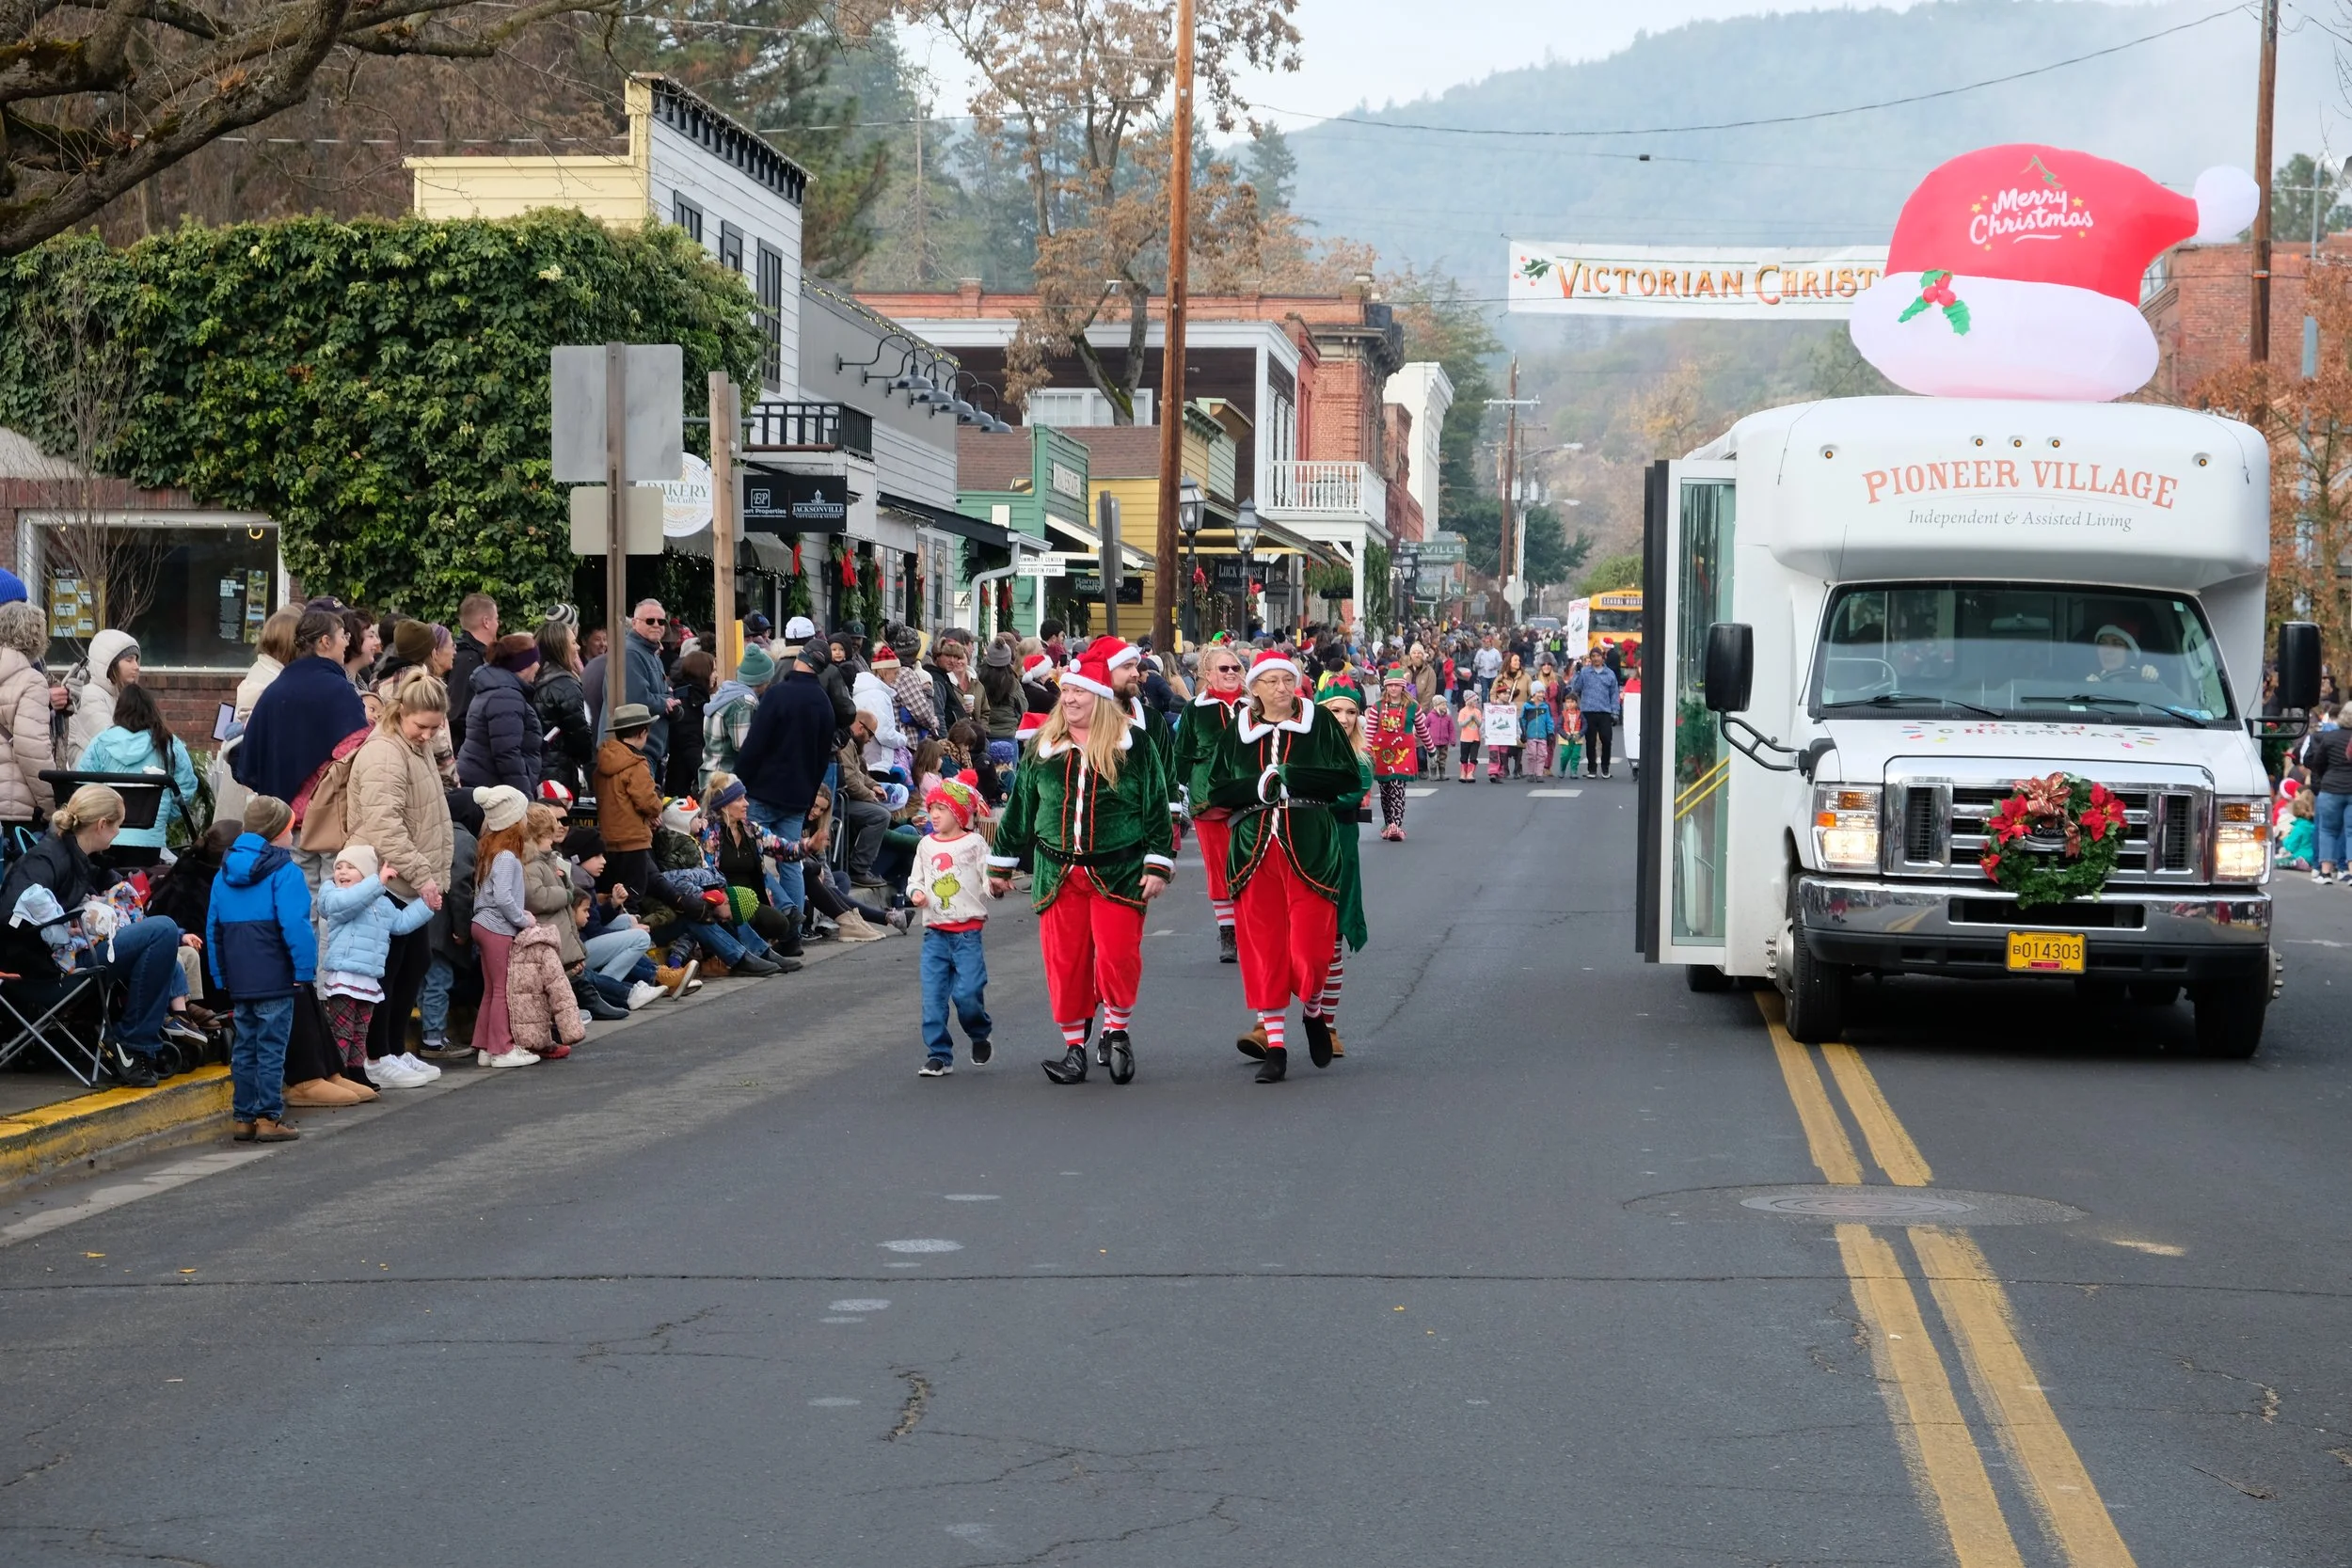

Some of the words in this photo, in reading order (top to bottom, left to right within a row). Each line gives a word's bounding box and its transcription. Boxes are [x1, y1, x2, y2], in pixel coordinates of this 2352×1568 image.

[1992, 188, 2068, 215] Merry
[1969, 206, 2094, 245] Christmas
[1554, 261, 1744, 300] VICTORIAN
[1753, 263, 1881, 305] CHRIST
[1862, 459, 2020, 504] PIONEER
[2030, 460, 2178, 509] VILLAGE
[1908, 509, 1998, 528] Independent
[2003, 510, 2018, 525] &
[2022, 510, 2080, 527] Assisted
[2085, 512, 2132, 532] Living
[1074, 577, 1100, 585] Rams
[1218, 563, 1237, 578] LOCK
[1075, 583, 1103, 594] Realty
